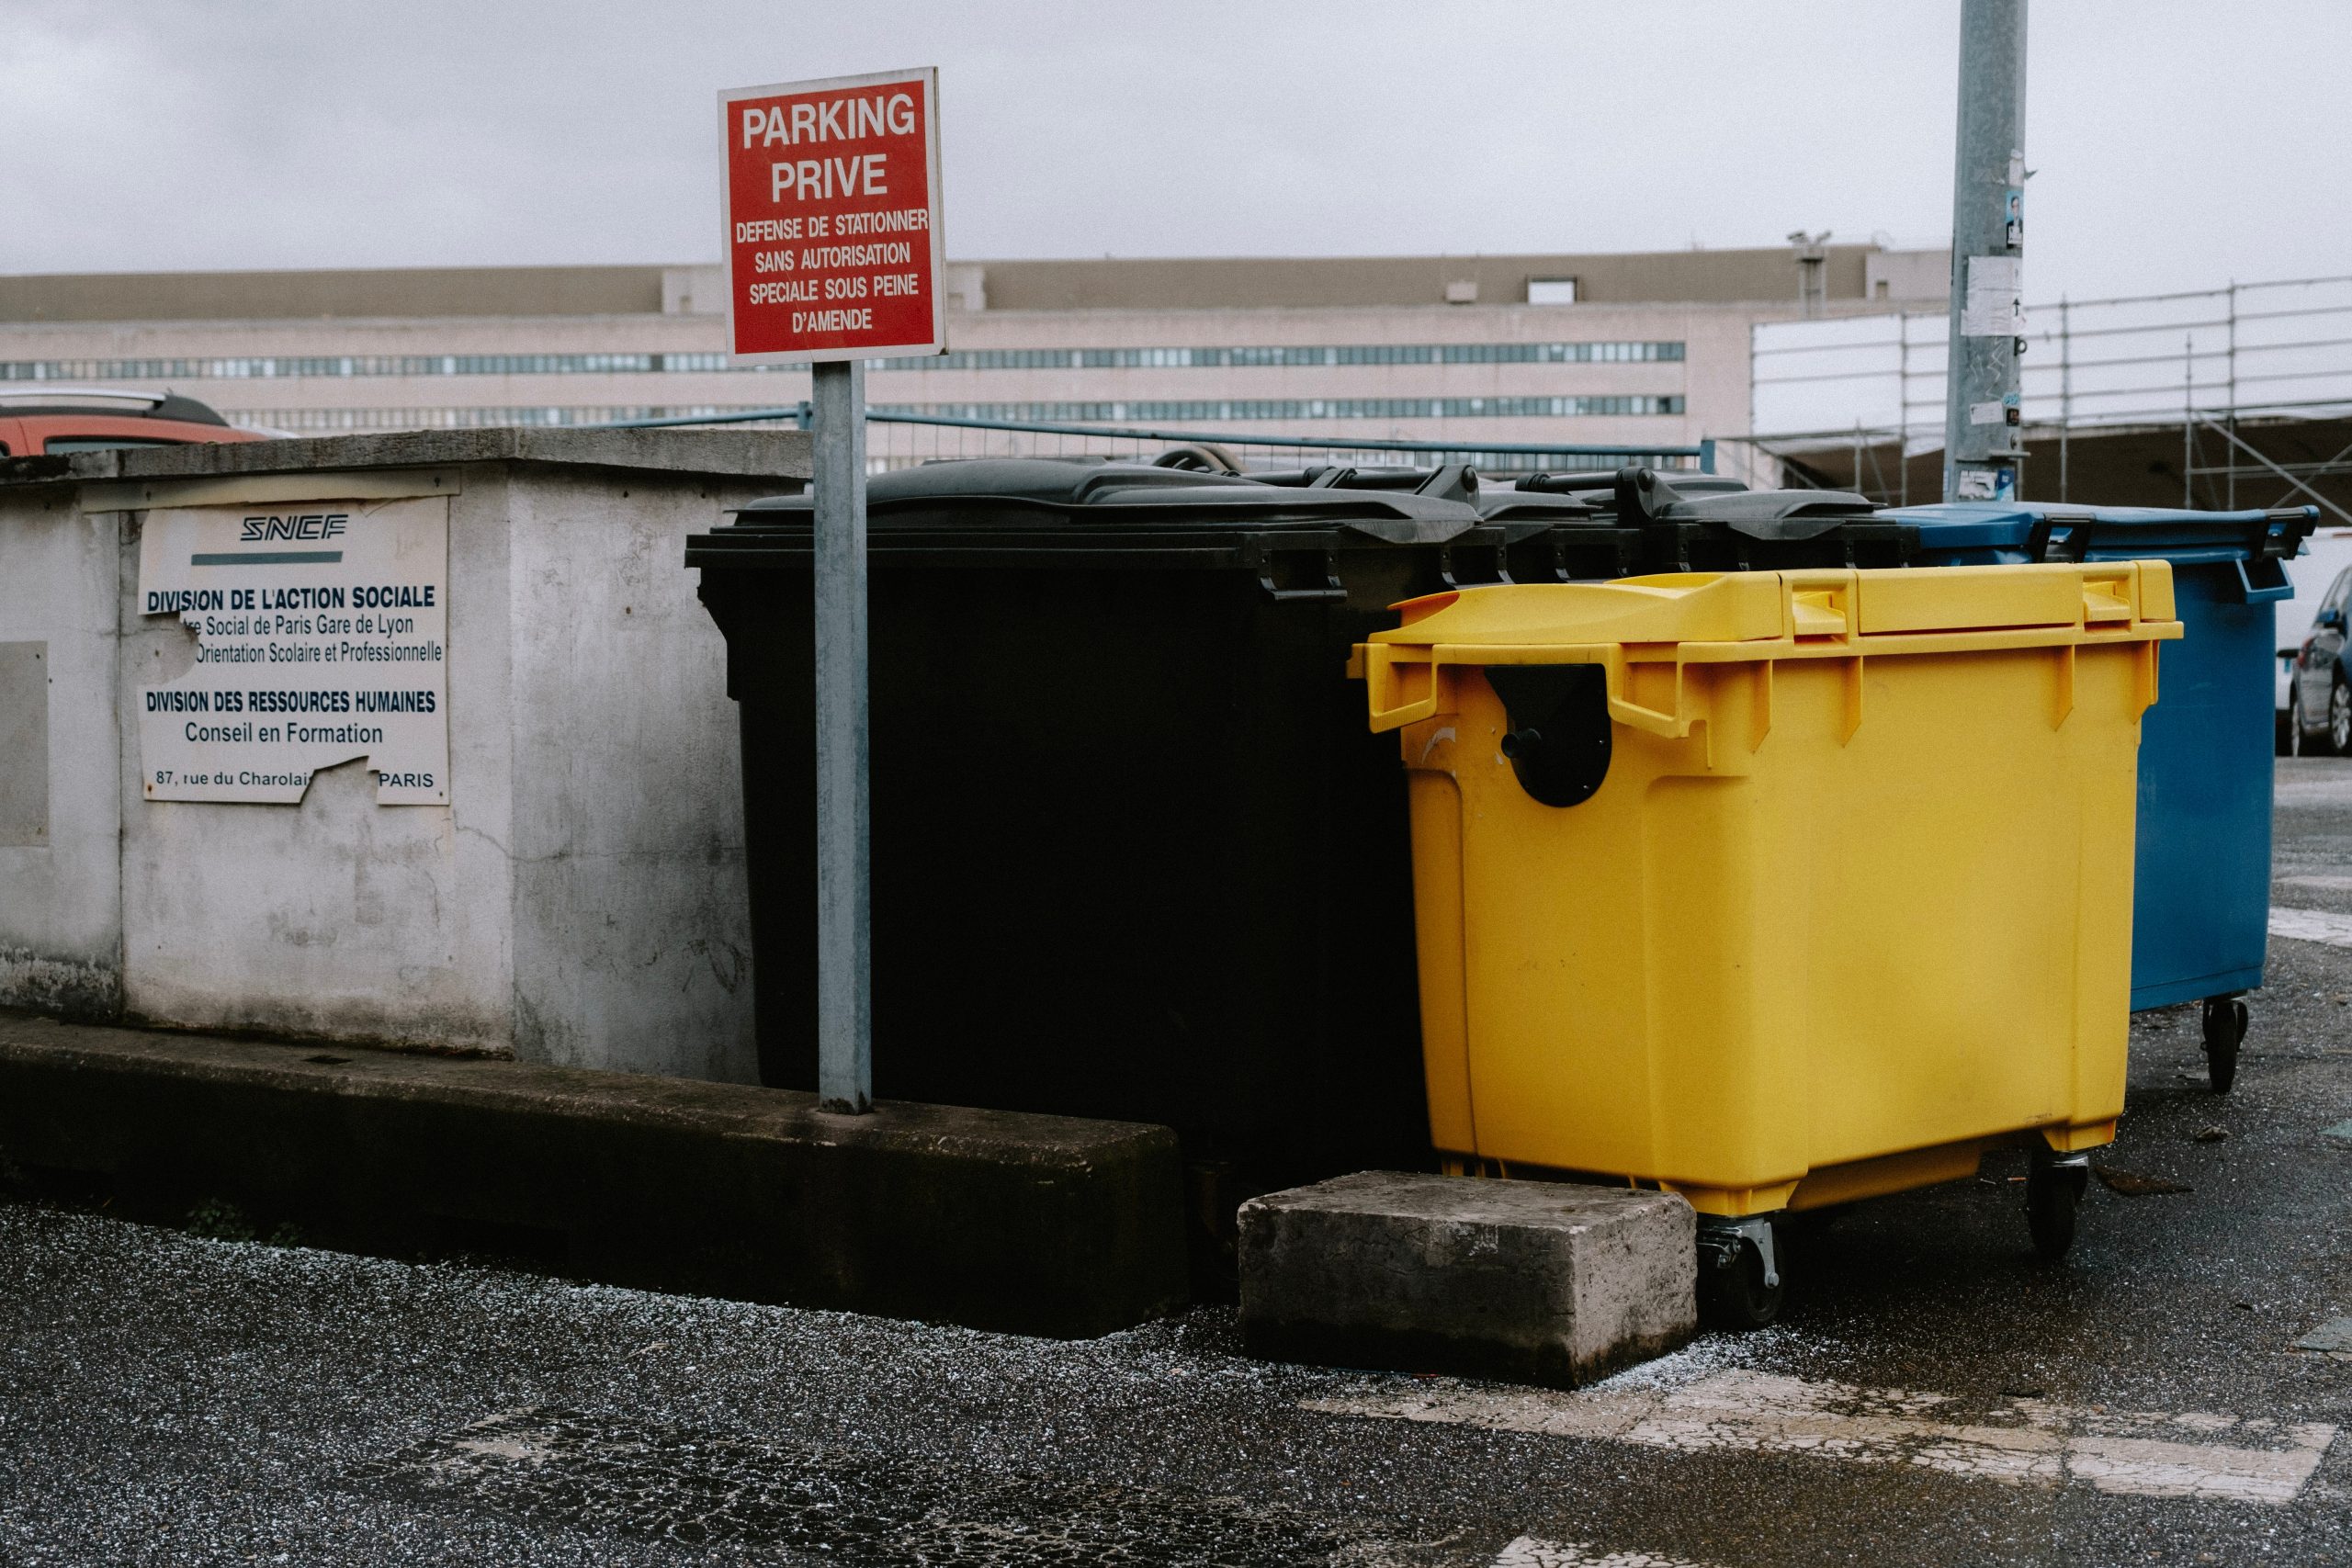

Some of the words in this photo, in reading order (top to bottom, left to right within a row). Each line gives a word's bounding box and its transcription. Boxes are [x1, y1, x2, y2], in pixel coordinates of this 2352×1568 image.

[742, 93, 915, 149] PARKING
[772, 153, 888, 203] PRIVE
[736, 218, 802, 243] DEFENSE
[808, 215, 829, 238] DE
[835, 209, 929, 235] STATIONNER
[755, 250, 794, 274] SANS
[801, 242, 910, 270] AUTORISATION
[750, 279, 819, 305] SPECIALE
[825, 276, 867, 299] SOUS
[874, 273, 919, 297] PEINE
[792, 308, 872, 333] D'AMENDE
[240, 513, 349, 541] SNCF
[148, 590, 223, 612] DIVISION
[232, 589, 255, 610] DE
[262, 586, 345, 610] L'ACTION
[352, 585, 435, 608] SOCIALE
[207, 615, 249, 636] Social
[254, 615, 271, 635] de
[276, 615, 311, 635] Paris
[317, 614, 351, 634] Gare
[356, 613, 373, 634] de
[378, 613, 413, 638] Lyon
[269, 641, 321, 662] Scolaire
[325, 644, 337, 662] et
[341, 640, 442, 662] Professionnelle
[146, 691, 209, 712] DIVISION
[214, 691, 243, 712] DES
[248, 691, 350, 712] RESSOURCES
[356, 691, 435, 713] HUMAINES
[185, 722, 253, 742] Conseil
[258, 727, 280, 742] en
[287, 722, 383, 743] Formation
[156, 771, 178, 786] 87,
[184, 773, 209, 785] rue
[214, 772, 233, 784] du
[379, 773, 434, 787] PARIS
